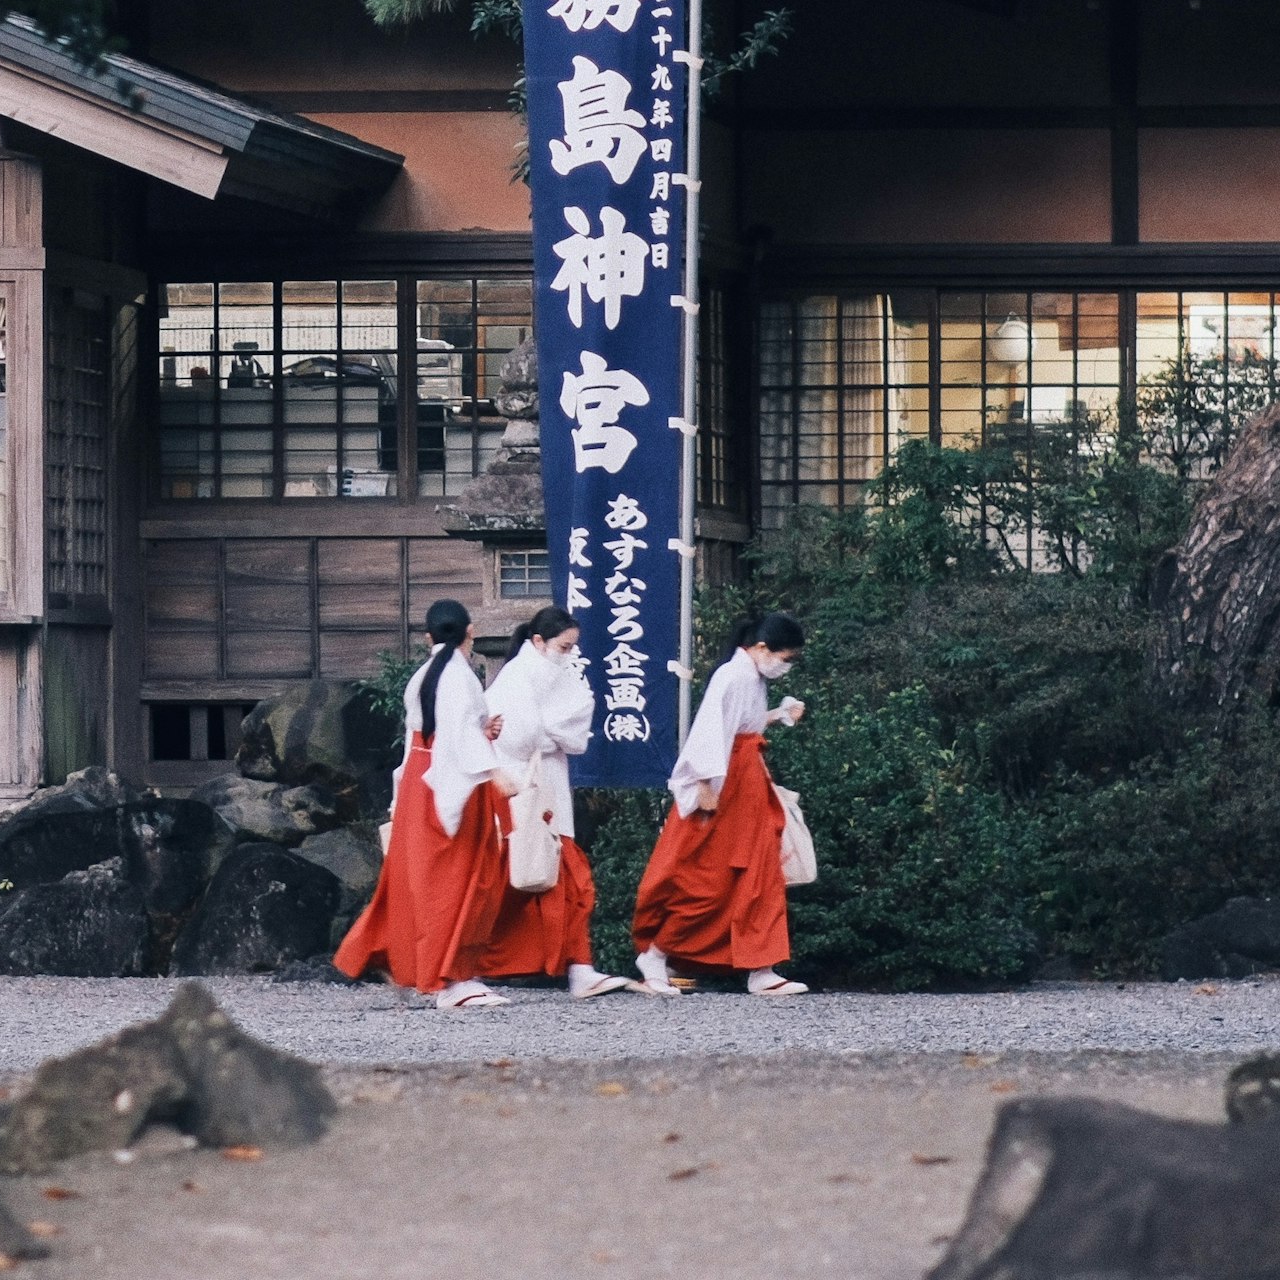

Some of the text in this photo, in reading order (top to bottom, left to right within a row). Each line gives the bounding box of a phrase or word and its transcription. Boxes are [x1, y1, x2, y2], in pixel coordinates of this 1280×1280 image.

[603, 493, 651, 742] あすなろ企画(株)
